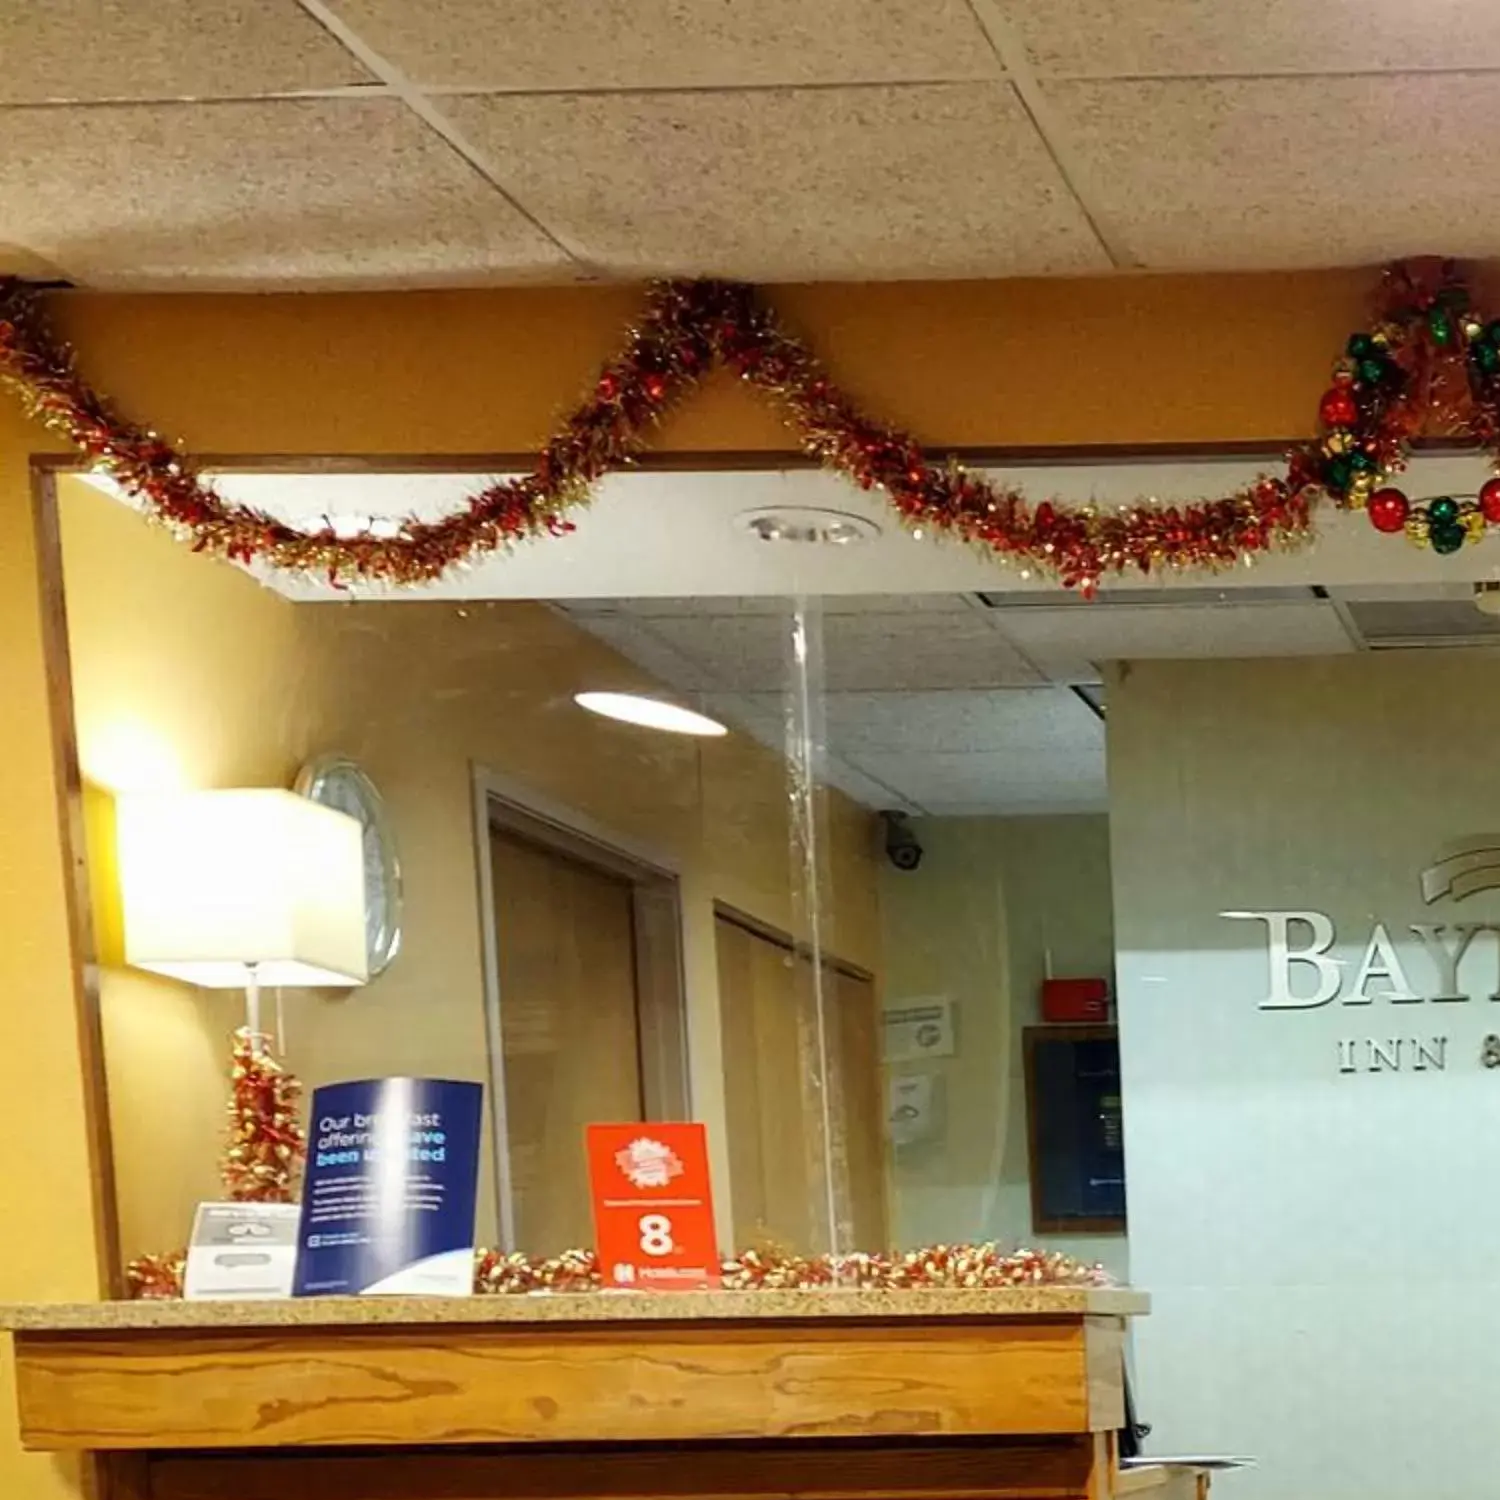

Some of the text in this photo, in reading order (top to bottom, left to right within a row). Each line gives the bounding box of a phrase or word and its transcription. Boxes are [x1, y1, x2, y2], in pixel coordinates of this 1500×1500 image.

[1337, 1035, 1449, 1073] INN
[319, 1113, 441, 1132] Our brast
[317, 1129, 447, 1150] offerin ave
[316, 1148, 446, 1168] been uted
[639, 1214, 674, 1256] 8
